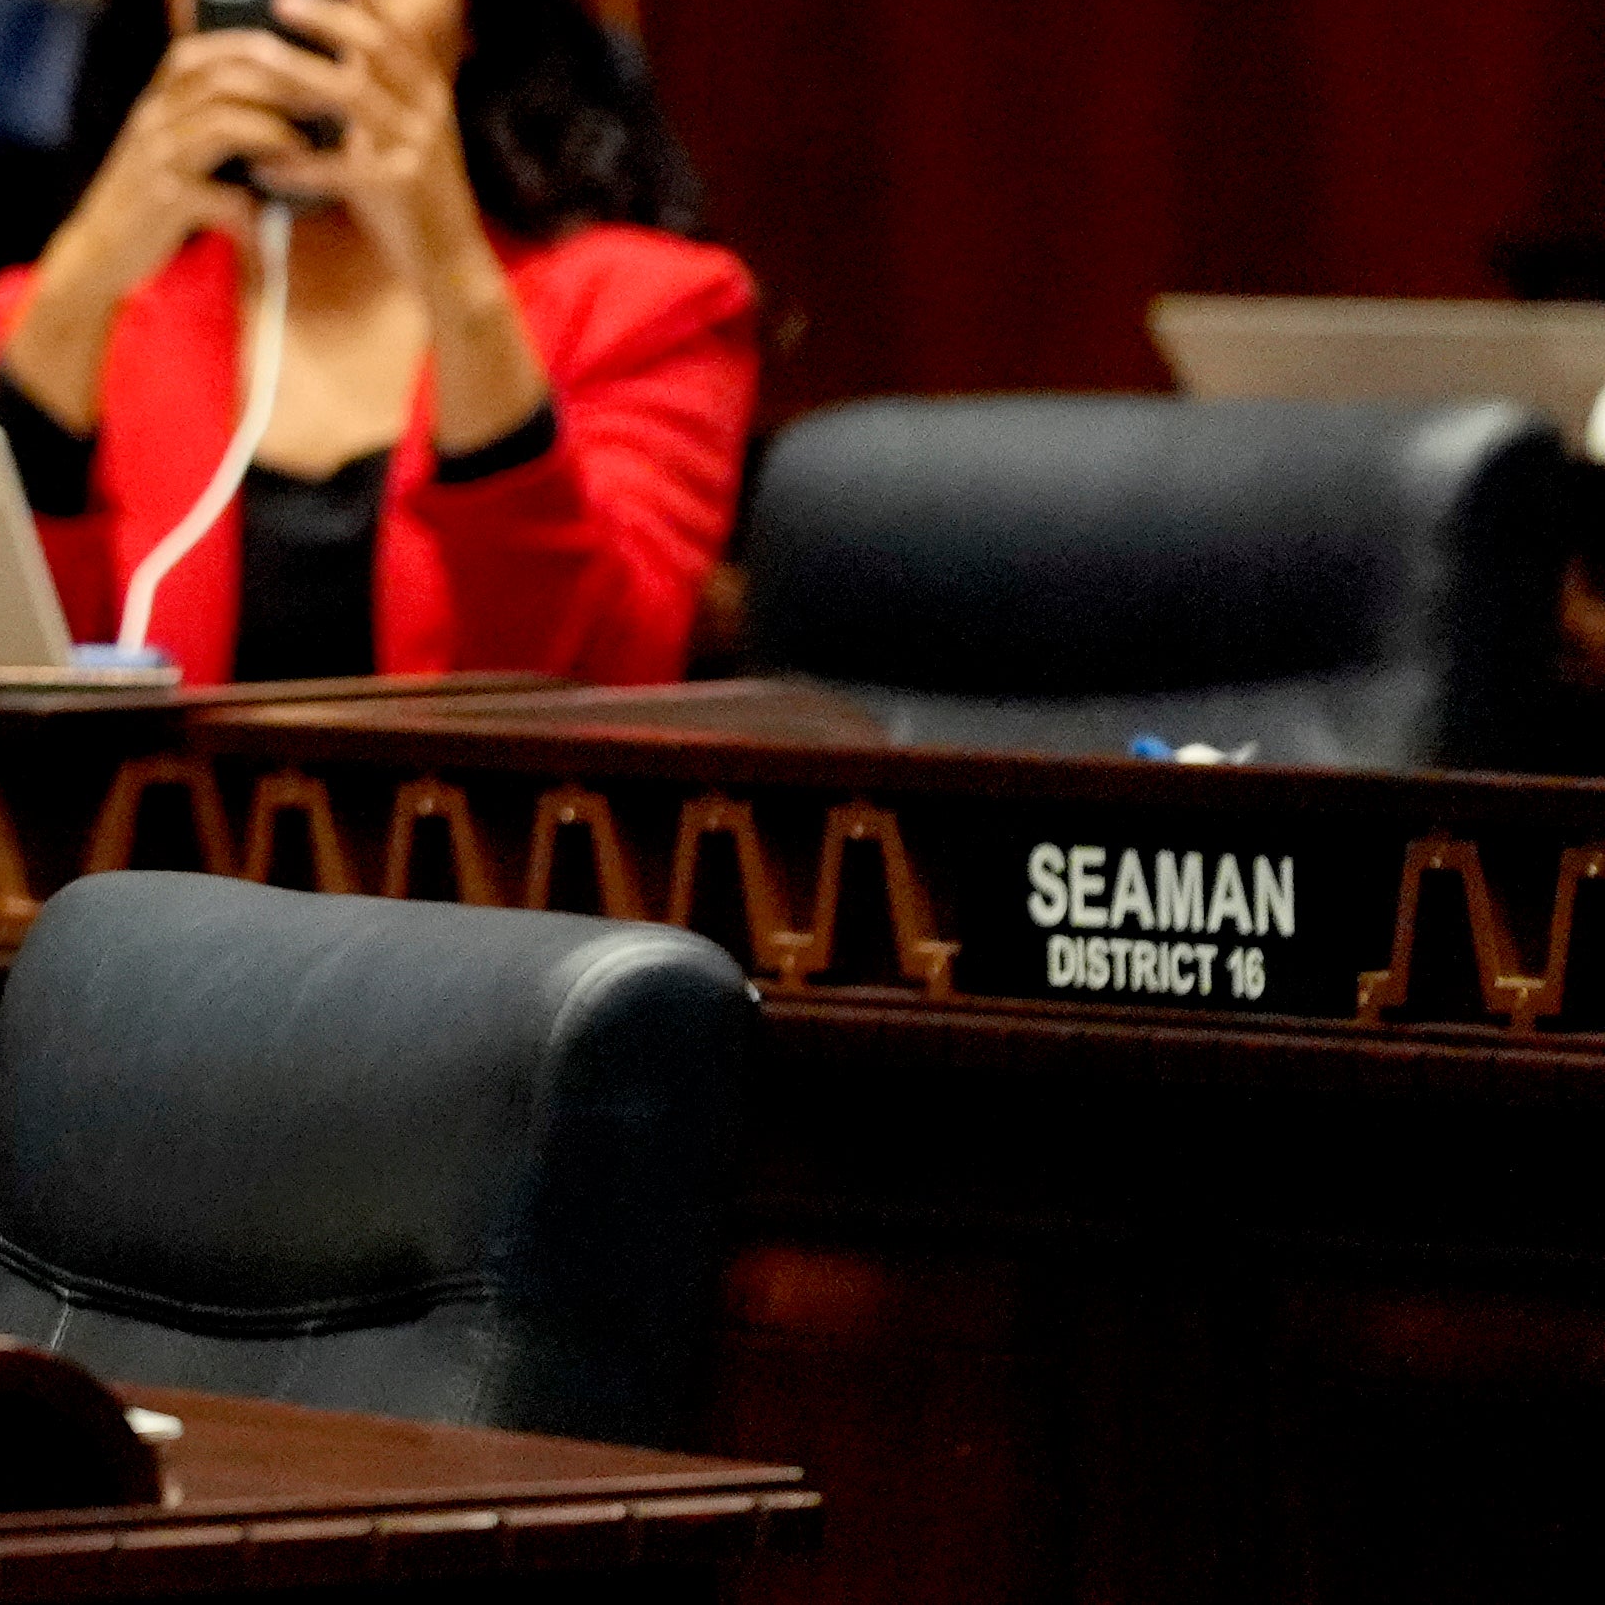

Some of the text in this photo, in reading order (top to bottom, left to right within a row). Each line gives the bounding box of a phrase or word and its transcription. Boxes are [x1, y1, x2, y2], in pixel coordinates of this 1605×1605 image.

[1026, 842, 1295, 937] SEAMAN
[1046, 933, 1267, 1001] DISTRICT 16
